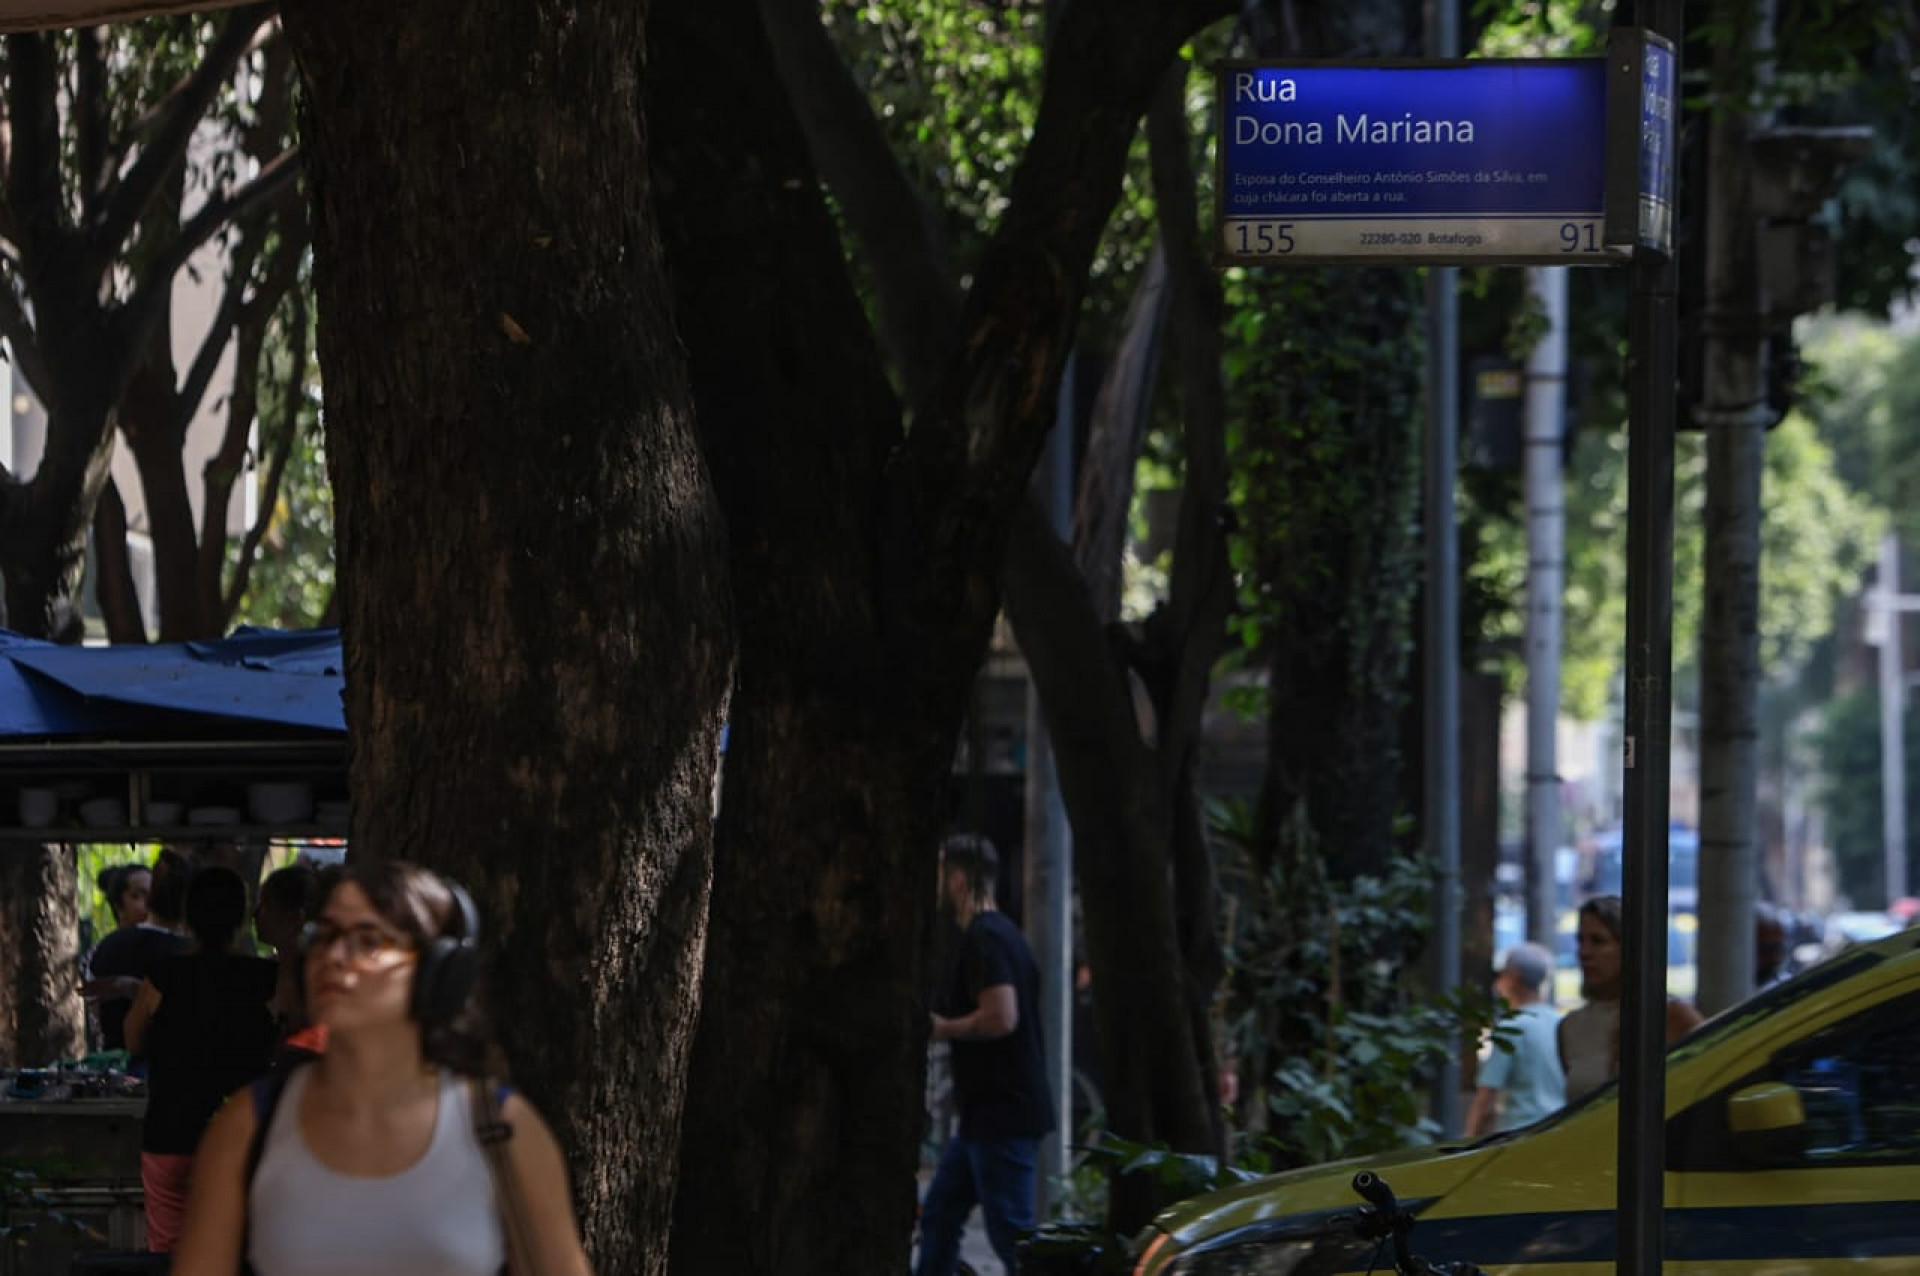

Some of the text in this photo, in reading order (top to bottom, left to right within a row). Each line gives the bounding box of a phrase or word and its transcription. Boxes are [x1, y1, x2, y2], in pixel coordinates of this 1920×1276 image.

[1235, 73, 1297, 102] Rua
[1235, 112, 1475, 145] Dona Mariana
[1235, 173, 1276, 188] Esposa
[1280, 172, 1295, 184] do
[1299, 172, 1371, 184] Conselheiro
[1474, 170, 1490, 183] da
[1527, 173, 1549, 183] em
[1311, 190, 1327, 203] foi
[1331, 190, 1369, 202] aberta
[1236, 225, 1294, 254] 155
[1560, 222, 1600, 253] 91
